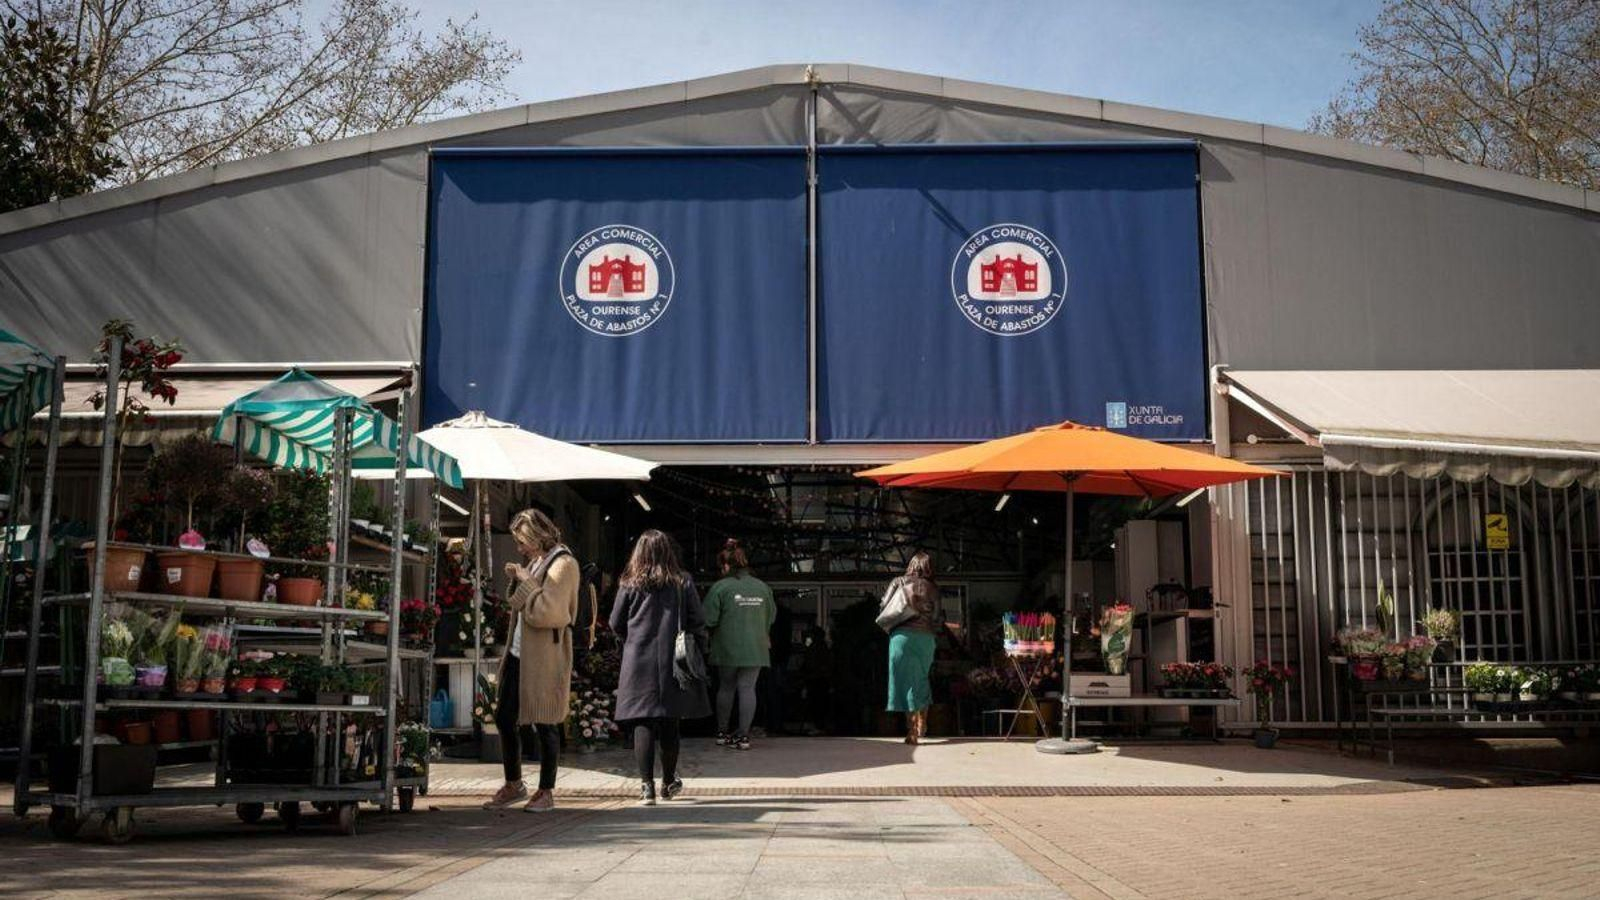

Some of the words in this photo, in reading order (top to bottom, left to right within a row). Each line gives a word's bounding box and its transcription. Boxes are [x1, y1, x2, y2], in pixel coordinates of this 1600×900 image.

[601, 228, 663, 259] COMERCIAL
[991, 228, 1054, 258] COMERCIAL
[566, 294, 589, 322] PLAZA
[589, 317, 605, 330] DE
[605, 312, 652, 332] ABASTOS
[592, 306, 641, 315] OURENSE
[958, 294, 982, 322] PLAZA
[983, 317, 998, 329] DE
[1000, 311, 1046, 332] ABASTOS
[985, 305, 1034, 315] OURENSE
[1128, 406, 1163, 415] XUNTA
[1128, 415, 1142, 425] DE
[1143, 415, 1184, 425] GALICIA
